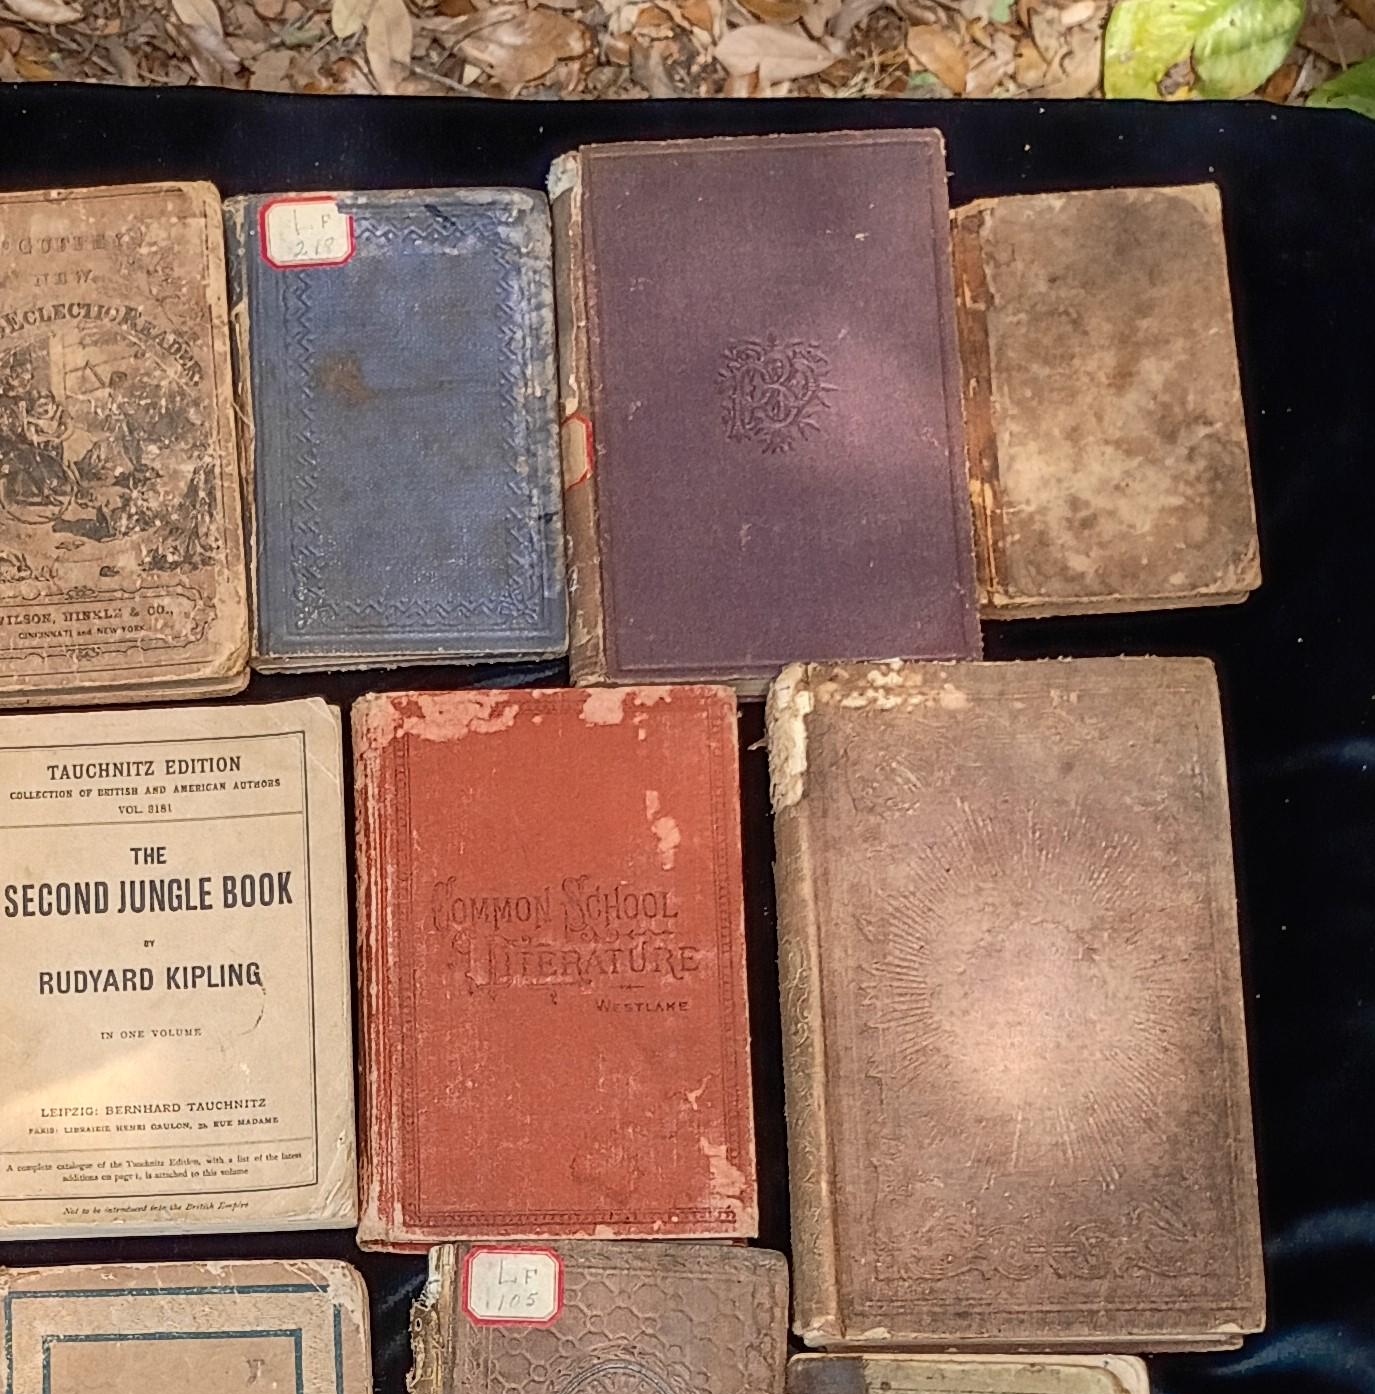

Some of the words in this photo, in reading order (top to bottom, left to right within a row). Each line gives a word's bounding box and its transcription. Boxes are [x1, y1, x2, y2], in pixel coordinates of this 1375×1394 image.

[34, 269, 93, 287] NEW
[4, 303, 120, 332] ECLECTIC
[18, 629, 73, 640] CINCINNATI
[76, 627, 92, 637] and
[97, 626, 119, 637] NEW
[47, 760, 155, 781] TAUCHNITZ
[165, 756, 242, 775] EDITION
[10, 789, 73, 801] COLLECTION
[79, 788, 92, 798] OF
[98, 786, 138, 797] BRITISH
[145, 785, 166, 796] AND
[174, 781, 226, 794] AMERICAN
[233, 778, 281, 790] AUTHORS
[130, 846, 167, 866] THE
[4, 881, 109, 918] SECOND
[117, 876, 213, 915] JUNGLE
[223, 871, 293, 908] BOOK
[143, 939, 155, 948] BY
[39, 967, 154, 995] RUDYARD
[166, 962, 261, 990] KIPLING
[596, 999, 689, 1013] WESTLAKE
[100, 1031, 113, 1040] IN
[120, 1030, 145, 1040] ONE
[152, 1028, 203, 1038] VOLUME
[40, 1106, 100, 1119] LEIPZIG:
[105, 1102, 181, 1116] BERNHARD
[187, 1098, 267, 1113] TAUCHNITZ
[237, 1116, 279, 1127] MADAME
[5, 1164, 13, 1173] A
[109, 1158, 123, 1168] the
[266, 1152, 279, 1162] the
